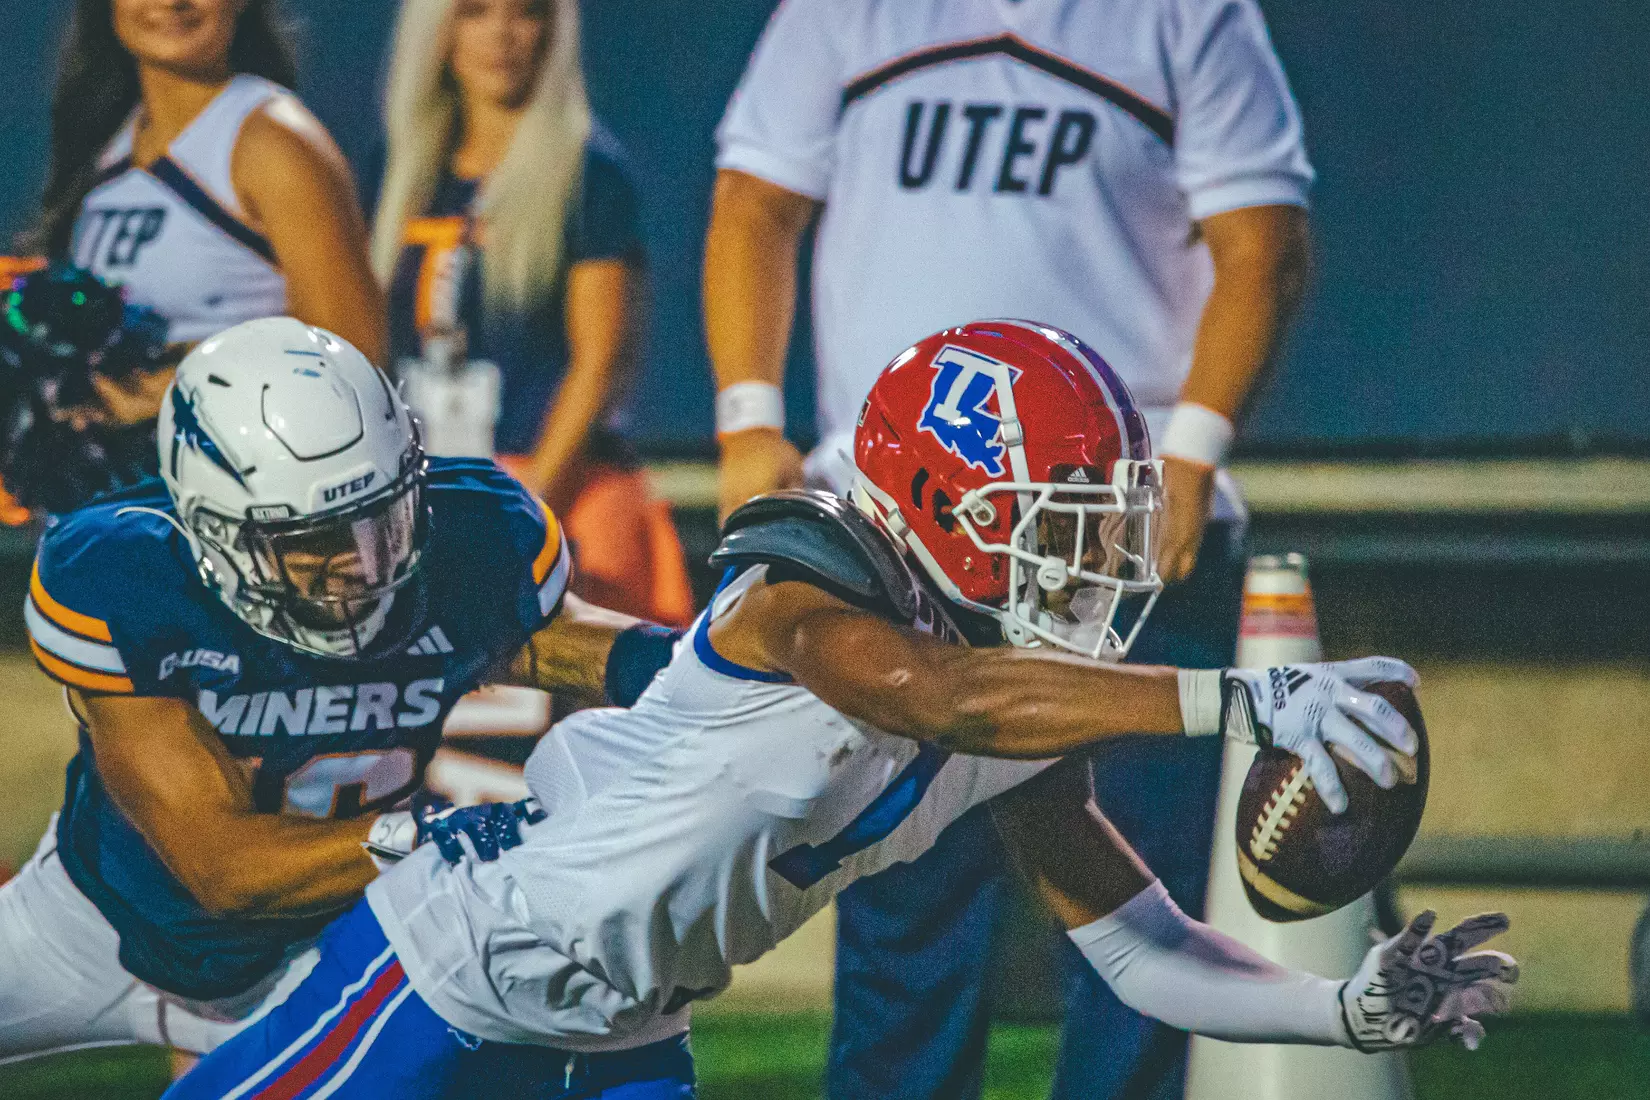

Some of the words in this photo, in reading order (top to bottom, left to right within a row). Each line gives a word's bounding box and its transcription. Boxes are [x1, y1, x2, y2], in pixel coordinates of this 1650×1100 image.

[900, 100, 1097, 195] UTEP
[324, 471, 376, 502] UTEP
[197, 677, 445, 736] MINERS
